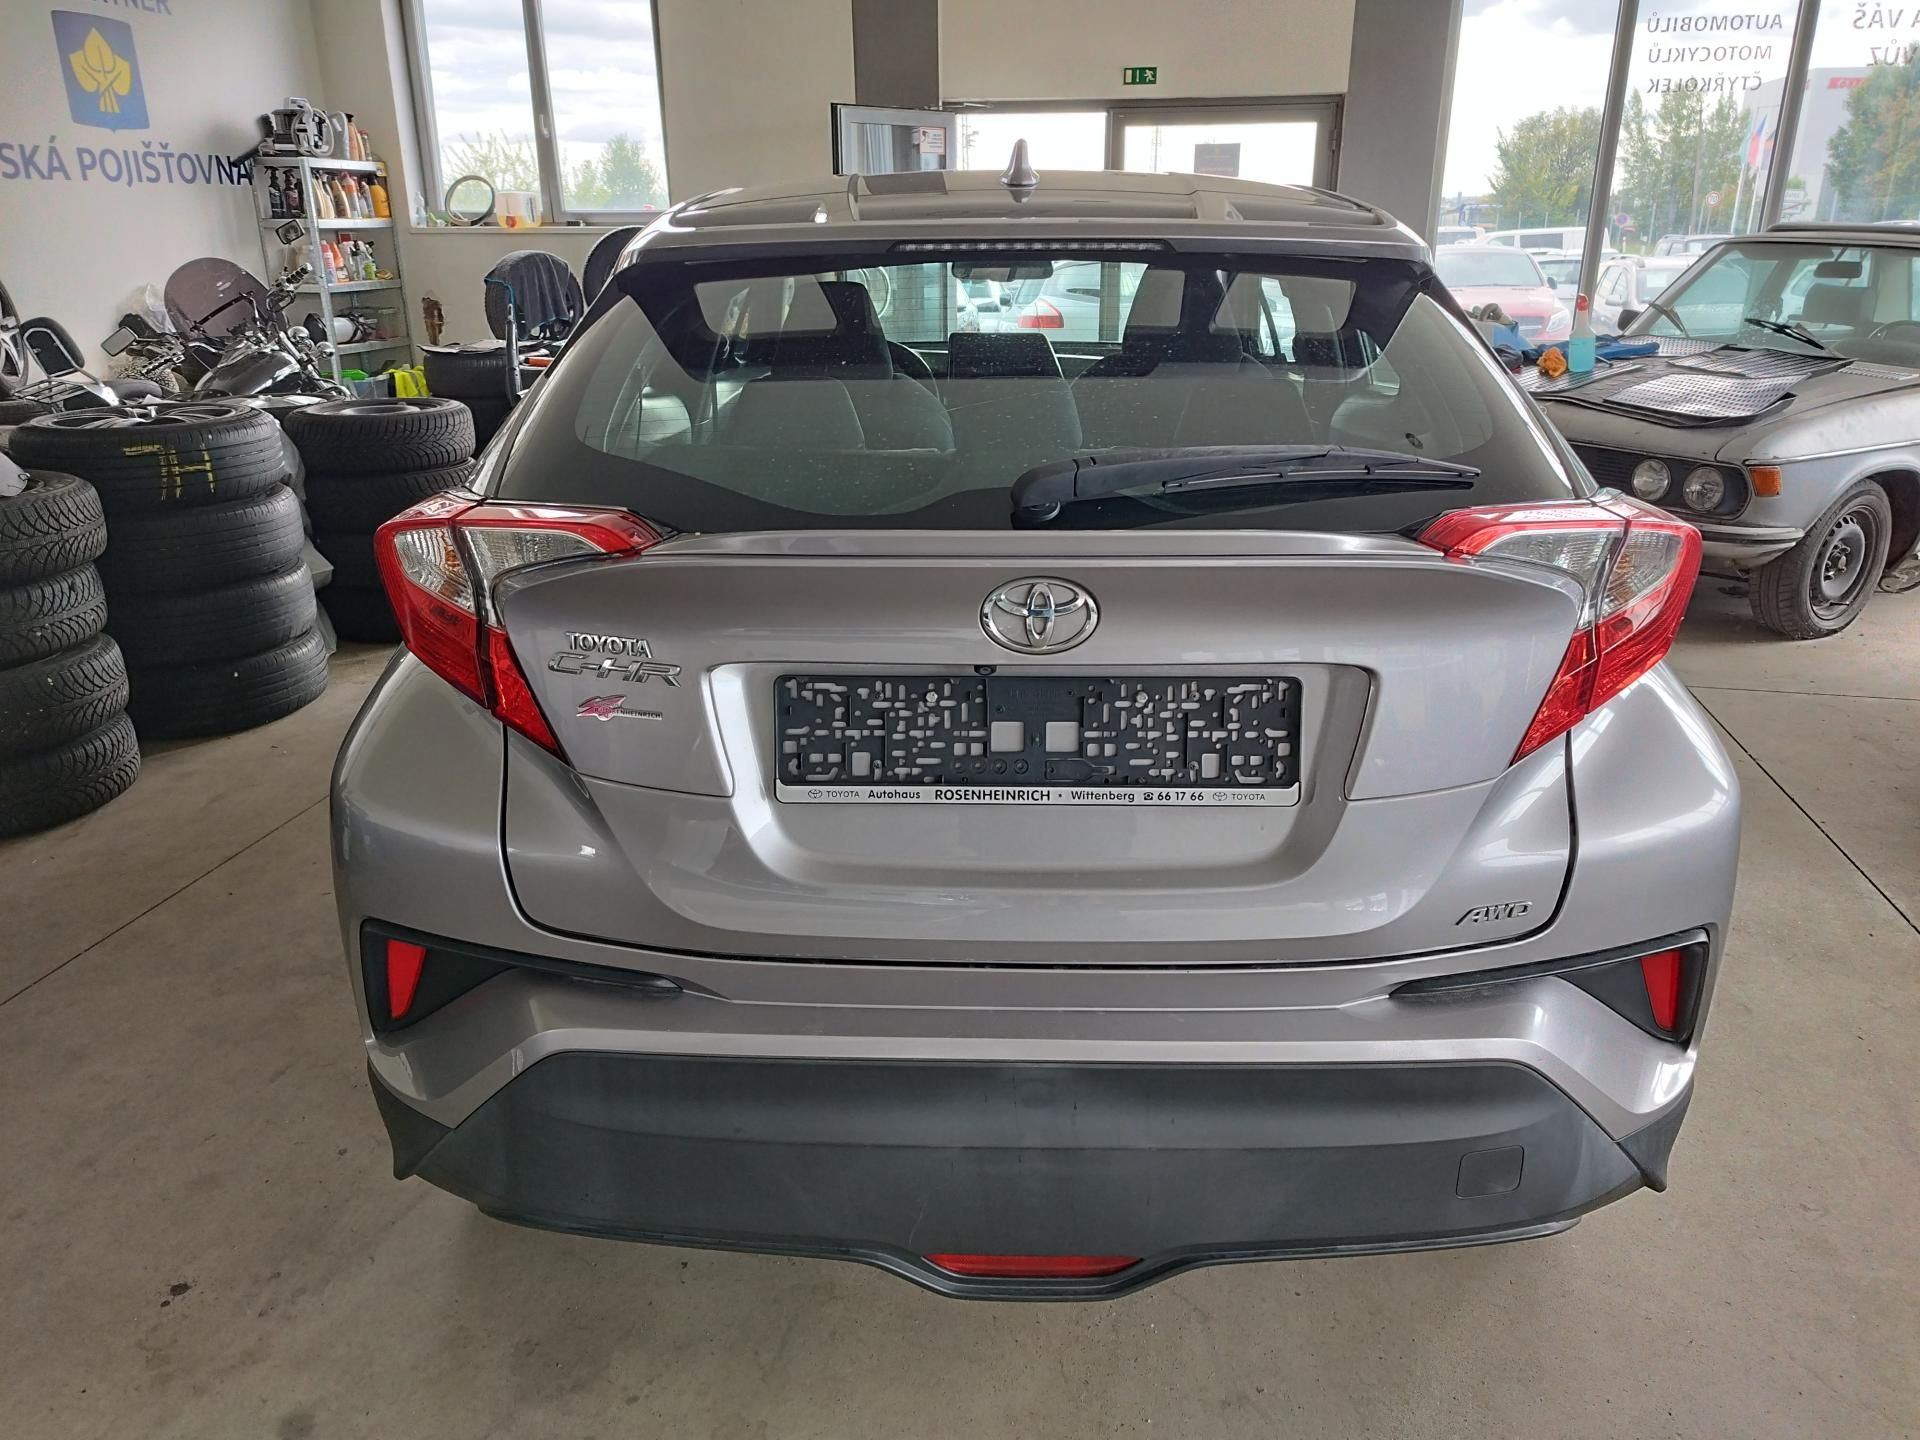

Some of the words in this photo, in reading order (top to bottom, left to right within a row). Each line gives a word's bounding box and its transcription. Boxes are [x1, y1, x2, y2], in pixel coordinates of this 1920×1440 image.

[76, 140, 253, 188] POJIŠŤOVNA
[566, 631, 653, 658] TOYOTA
[548, 651, 682, 688] C-HR
[825, 790, 860, 798] TOYOTA
[868, 789, 921, 799] Autohaus
[934, 789, 1050, 801] ROSENHEINRICH
[1071, 791, 1135, 802] Wittenberg
[1157, 792, 1171, 801] 66
[1175, 792, 1185, 801] 17
[1190, 792, 1204, 801] 66
[1232, 793, 1265, 801] TOYOTA
[1454, 900, 1533, 926] AWD
